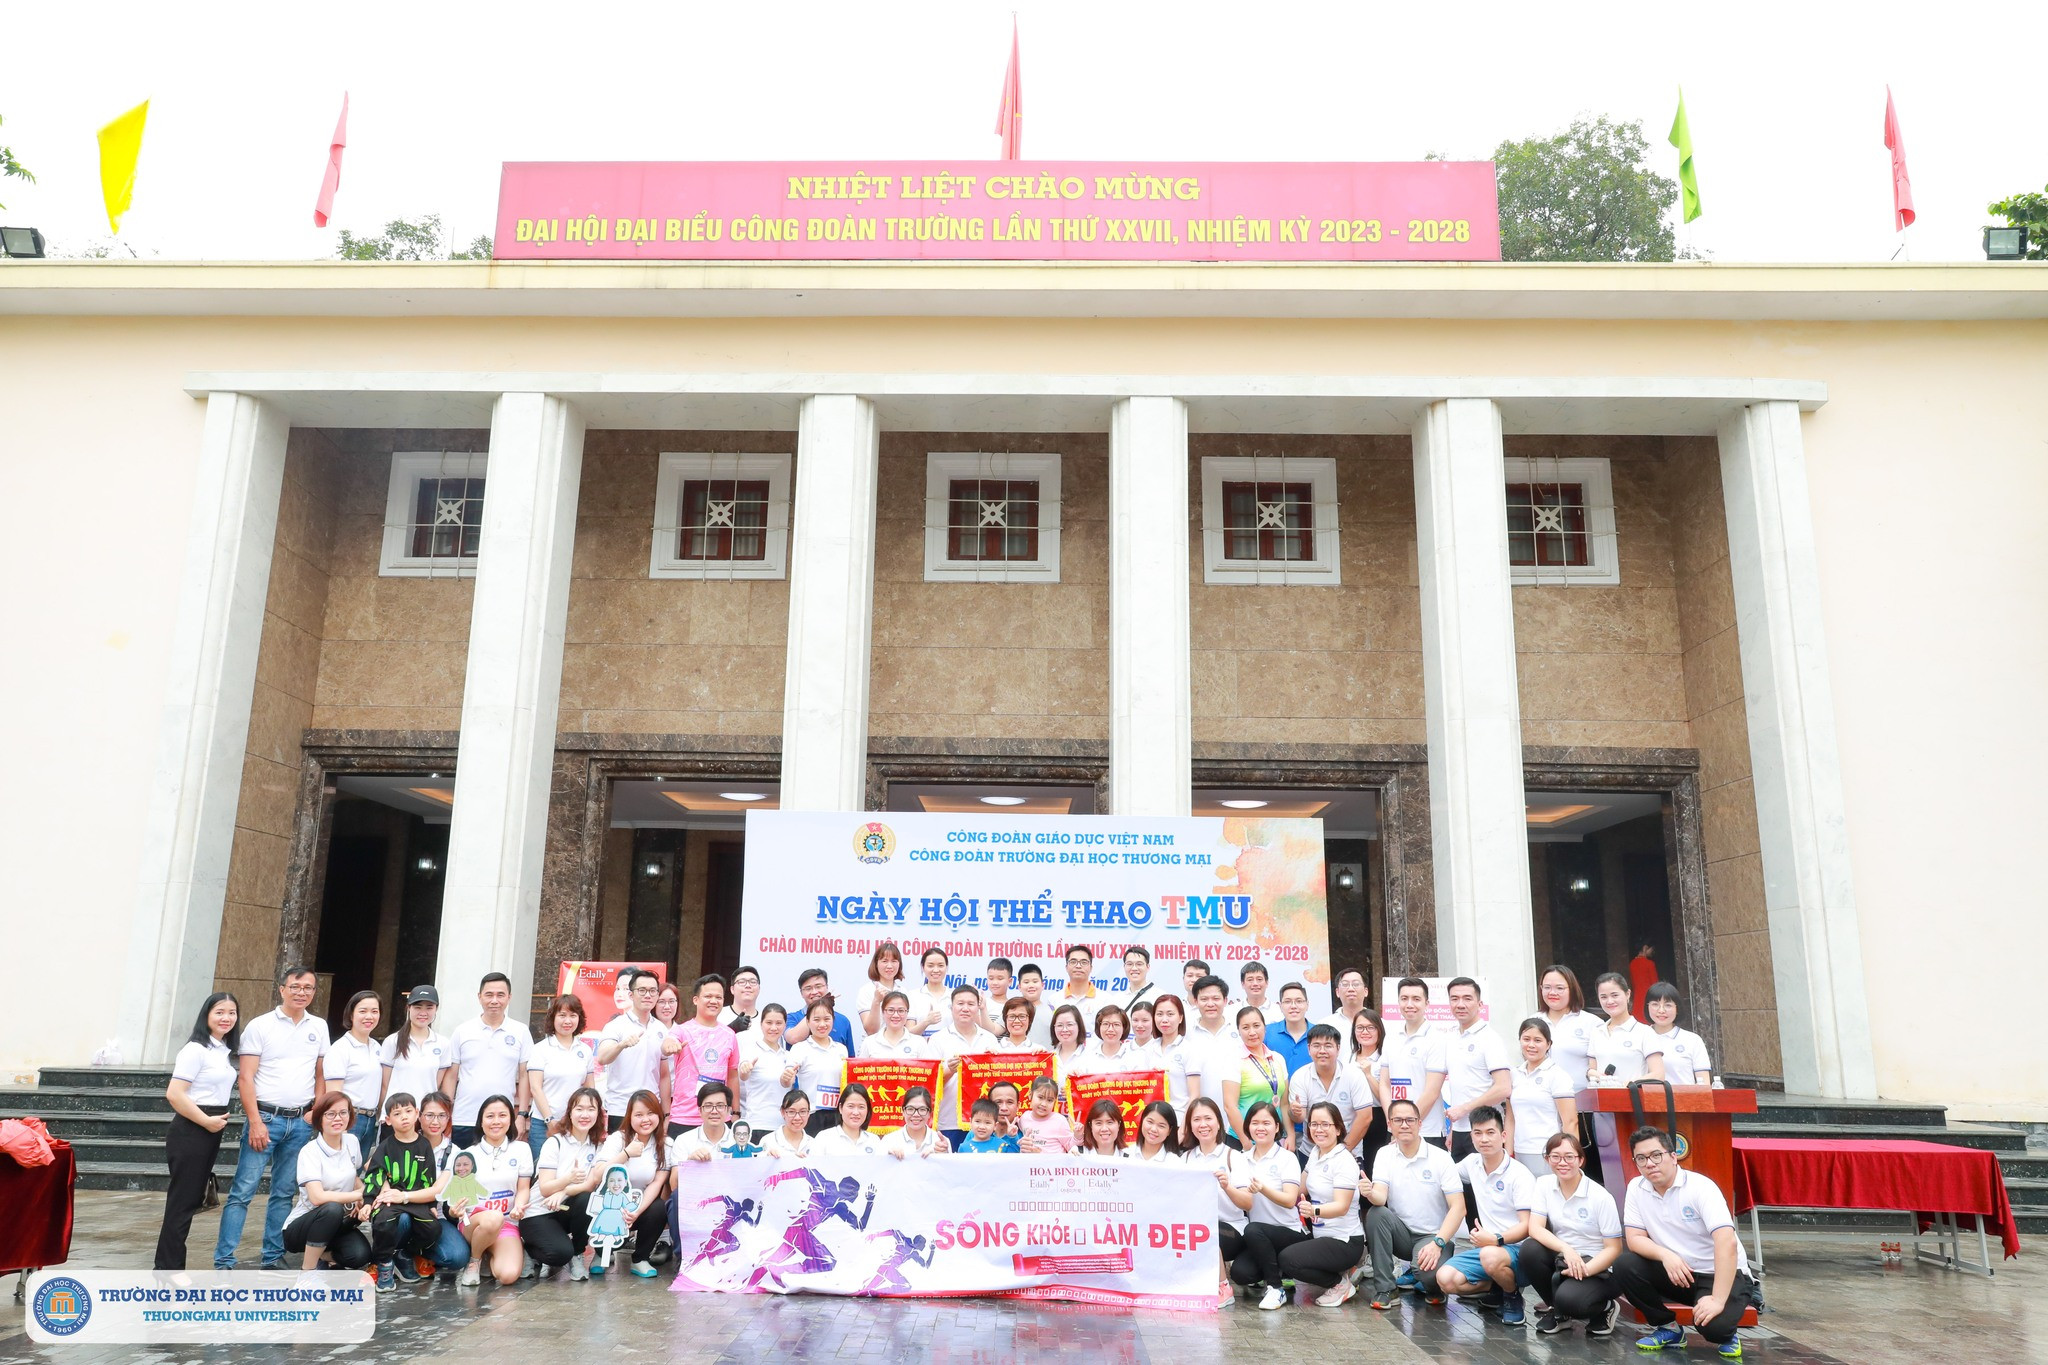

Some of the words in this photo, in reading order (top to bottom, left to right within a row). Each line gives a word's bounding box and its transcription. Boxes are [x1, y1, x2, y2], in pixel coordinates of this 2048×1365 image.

[788, 171, 892, 204] NHIỆT
[901, 171, 976, 204] LIỆT
[986, 174, 1085, 199] CHÀO
[1095, 174, 1200, 200] MỪNG
[517, 219, 558, 246] ĐẠI
[566, 214, 608, 246] HỘI
[615, 219, 657, 245] ĐẠI
[666, 210, 722, 240] BIỂU
[731, 214, 799, 241] CÔNG
[807, 214, 876, 240] ĐOÀN
[884, 213, 984, 240] TRƯỜNG
[993, 211, 1041, 240] LẦN
[1049, 214, 1100, 241] THỨ
[1106, 219, 1179, 244] XXVII,
[1188, 215, 1271, 247] NHIỆM
[1280, 215, 1312, 242] KỲ
[1320, 220, 1382, 242] 2023
[1408, 220, 1470, 242] 2028
[947, 829, 988, 844] CÔNG
[991, 829, 1031, 845] ĐOÀN
[1035, 831, 1071, 845] GIÁO
[1075, 833, 1105, 848] DỤC
[1108, 831, 1139, 848] VIỆT
[1142, 834, 1175, 847] NAM
[909, 846, 951, 862] CÔNG
[954, 847, 994, 863] ĐOÀN
[997, 848, 1056, 864] TRƯỜNG
[1059, 851, 1085, 867] ĐẠI
[1088, 852, 1119, 867] HỌC
[1122, 851, 1182, 866] THƯƠNG
[1184, 853, 1212, 868] MẠI
[816, 890, 911, 922] NGÀY
[919, 891, 980, 930] HỘI
[988, 888, 1053, 924] THỂ
[1061, 898, 1152, 926] THAO
[1161, 895, 1252, 928] TMU
[758, 934, 797, 954] CHÀO
[800, 935, 844, 955] MỪNG
[846, 937, 871, 958] ĐẠI
[945, 938, 984, 958] ĐOÀN
[987, 938, 1043, 959] TRƯỜNG
[1079, 941, 1106, 959] HỨ
[1154, 943, 1201, 962] NHIỆM
[1204, 941, 1222, 961] KỲ
[1226, 944, 1261, 962] 2023
[1274, 945, 1309, 962] 2028
[579, 968, 606, 981] Edally
[974, 977, 989, 991] ng
[1042, 975, 1065, 992] áng
[1111, 977, 1130, 991] 20
[822, 1092, 840, 1106] 017
[1392, 1086, 1407, 1100] 120
[872, 1104, 894, 1113] GIẢI
[1082, 1168, 1118, 1176] GROUP
[935, 1208, 1020, 1251] SỐNG
[1027, 1217, 1071, 1246] KHỎE
[1093, 1216, 1139, 1247] LÀM
[1147, 1222, 1211, 1259] ĐẸP
